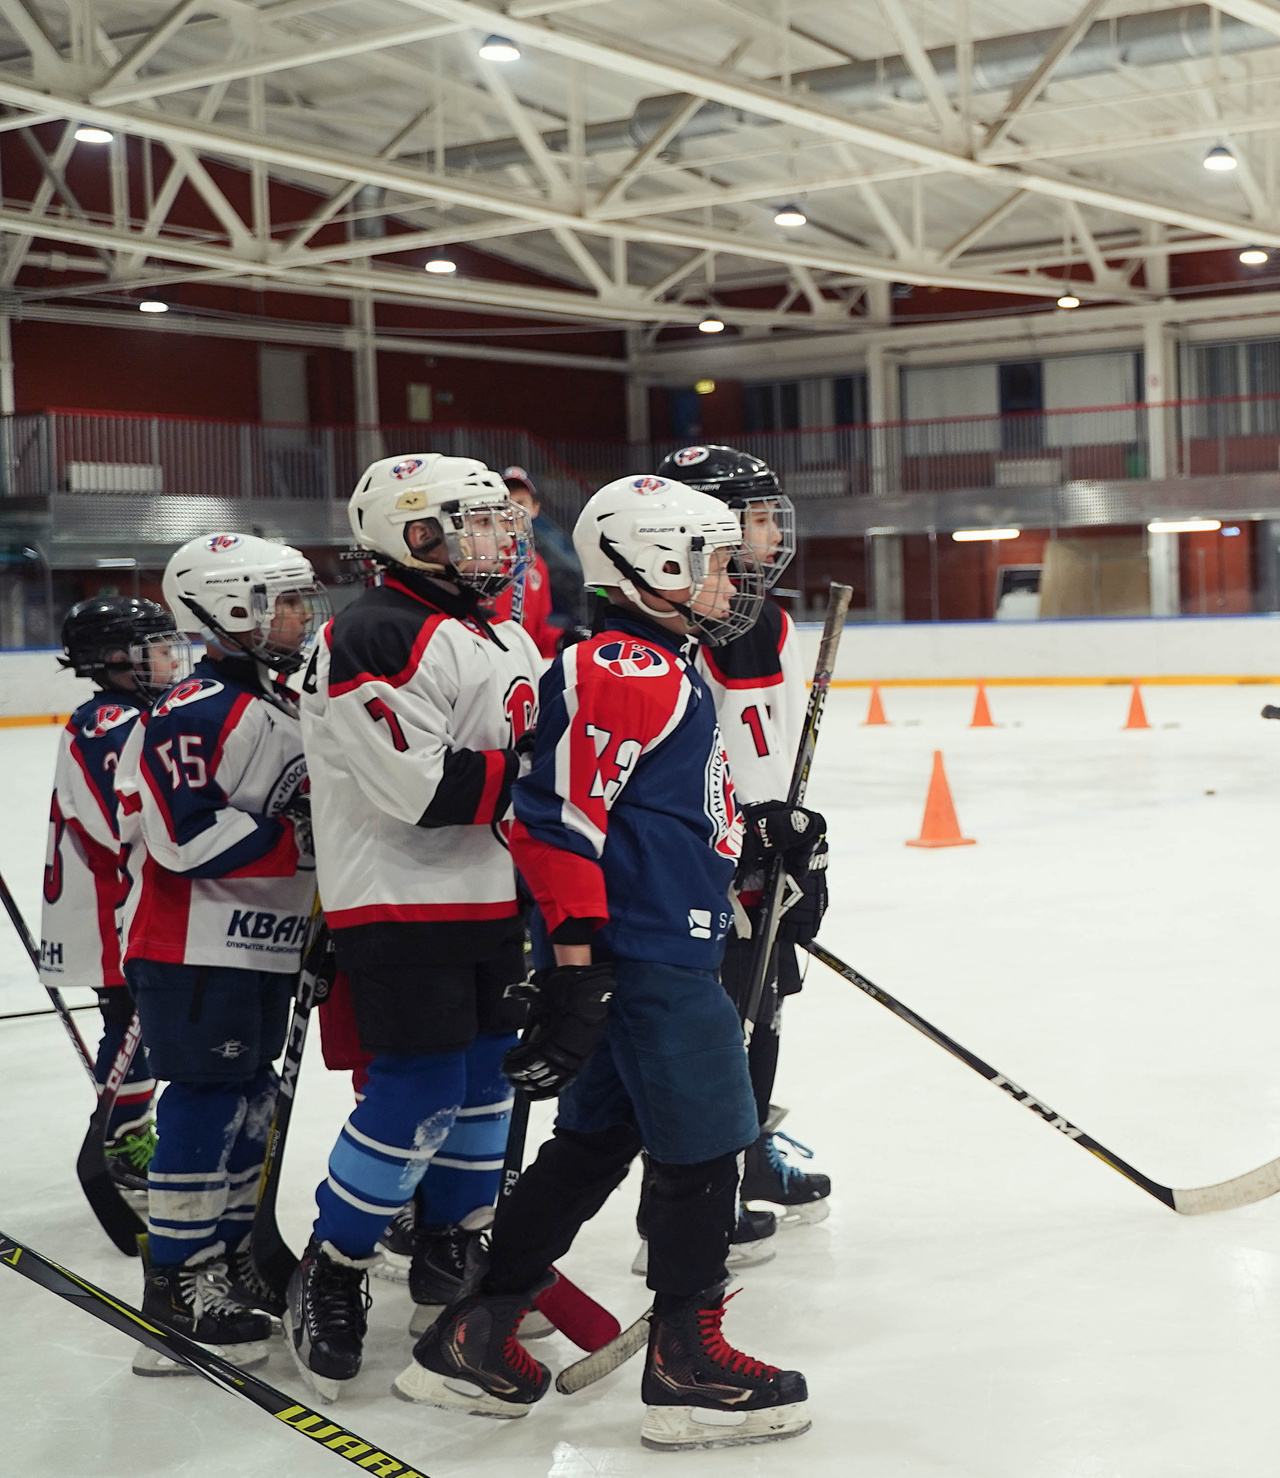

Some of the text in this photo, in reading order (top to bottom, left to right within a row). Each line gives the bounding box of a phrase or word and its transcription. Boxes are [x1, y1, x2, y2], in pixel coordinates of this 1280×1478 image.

[364, 696, 410, 753] 7
[741, 703, 772, 758] 1
[154, 734, 208, 790] 55
[280, 968, 317, 1099] CCM
[989, 1073, 1083, 1140] CCM
